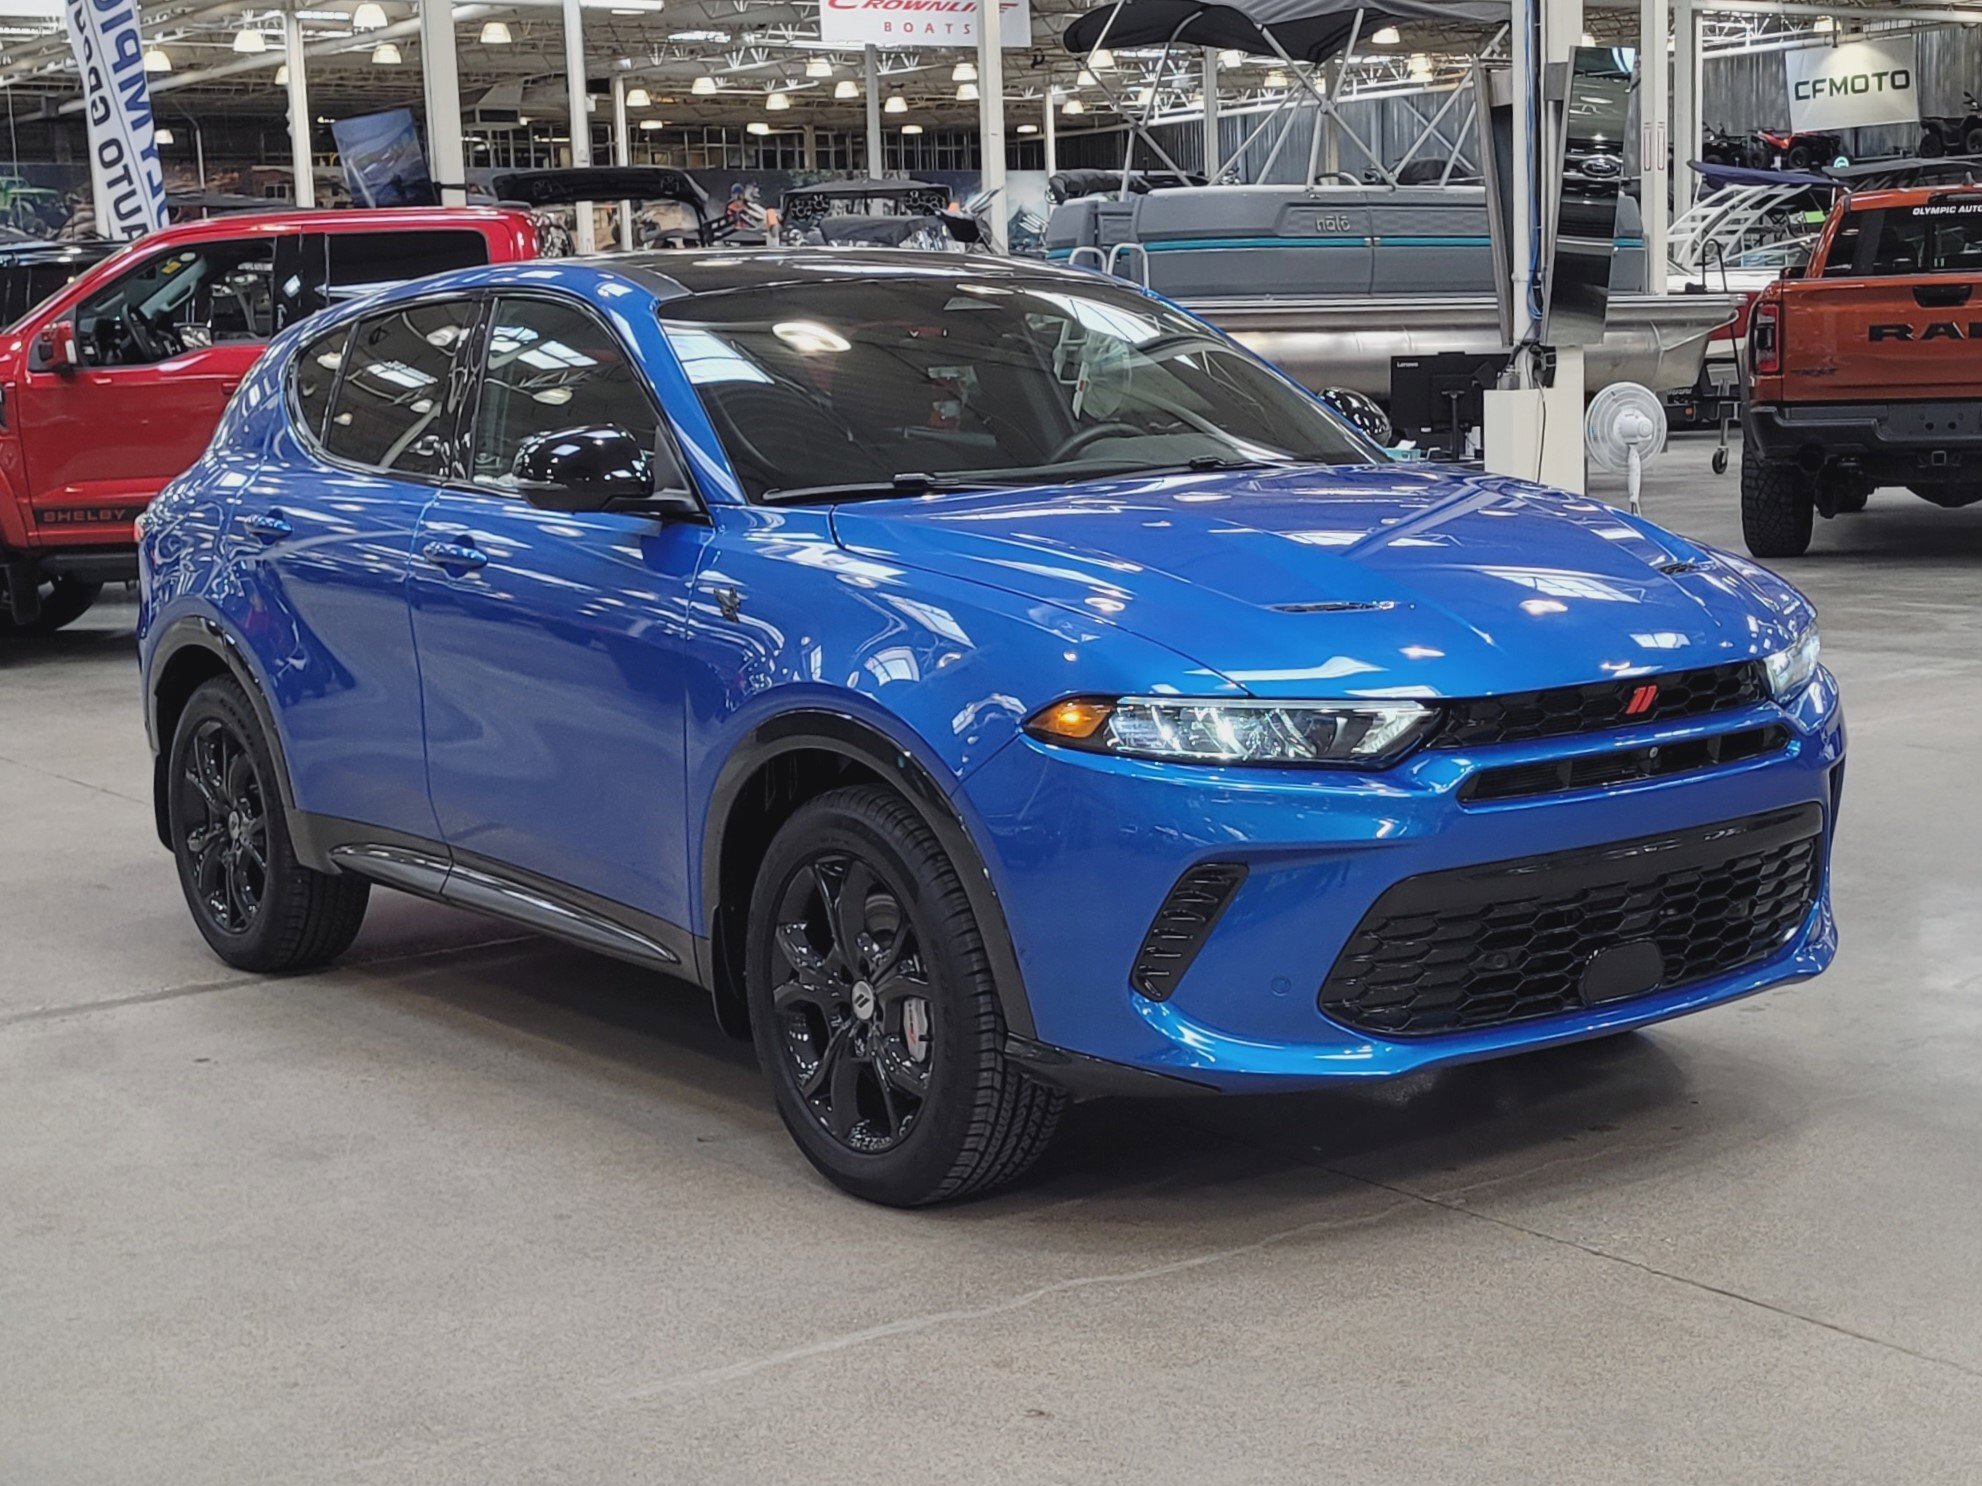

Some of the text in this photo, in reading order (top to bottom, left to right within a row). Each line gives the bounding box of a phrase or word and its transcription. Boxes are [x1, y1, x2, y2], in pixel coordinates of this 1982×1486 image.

[884, 21, 971, 35] BOATS
[1794, 69, 1910, 101] CFMOTO
[1912, 206, 1957, 216] OLYMPIC
[43, 509, 126, 523] SHELBY
